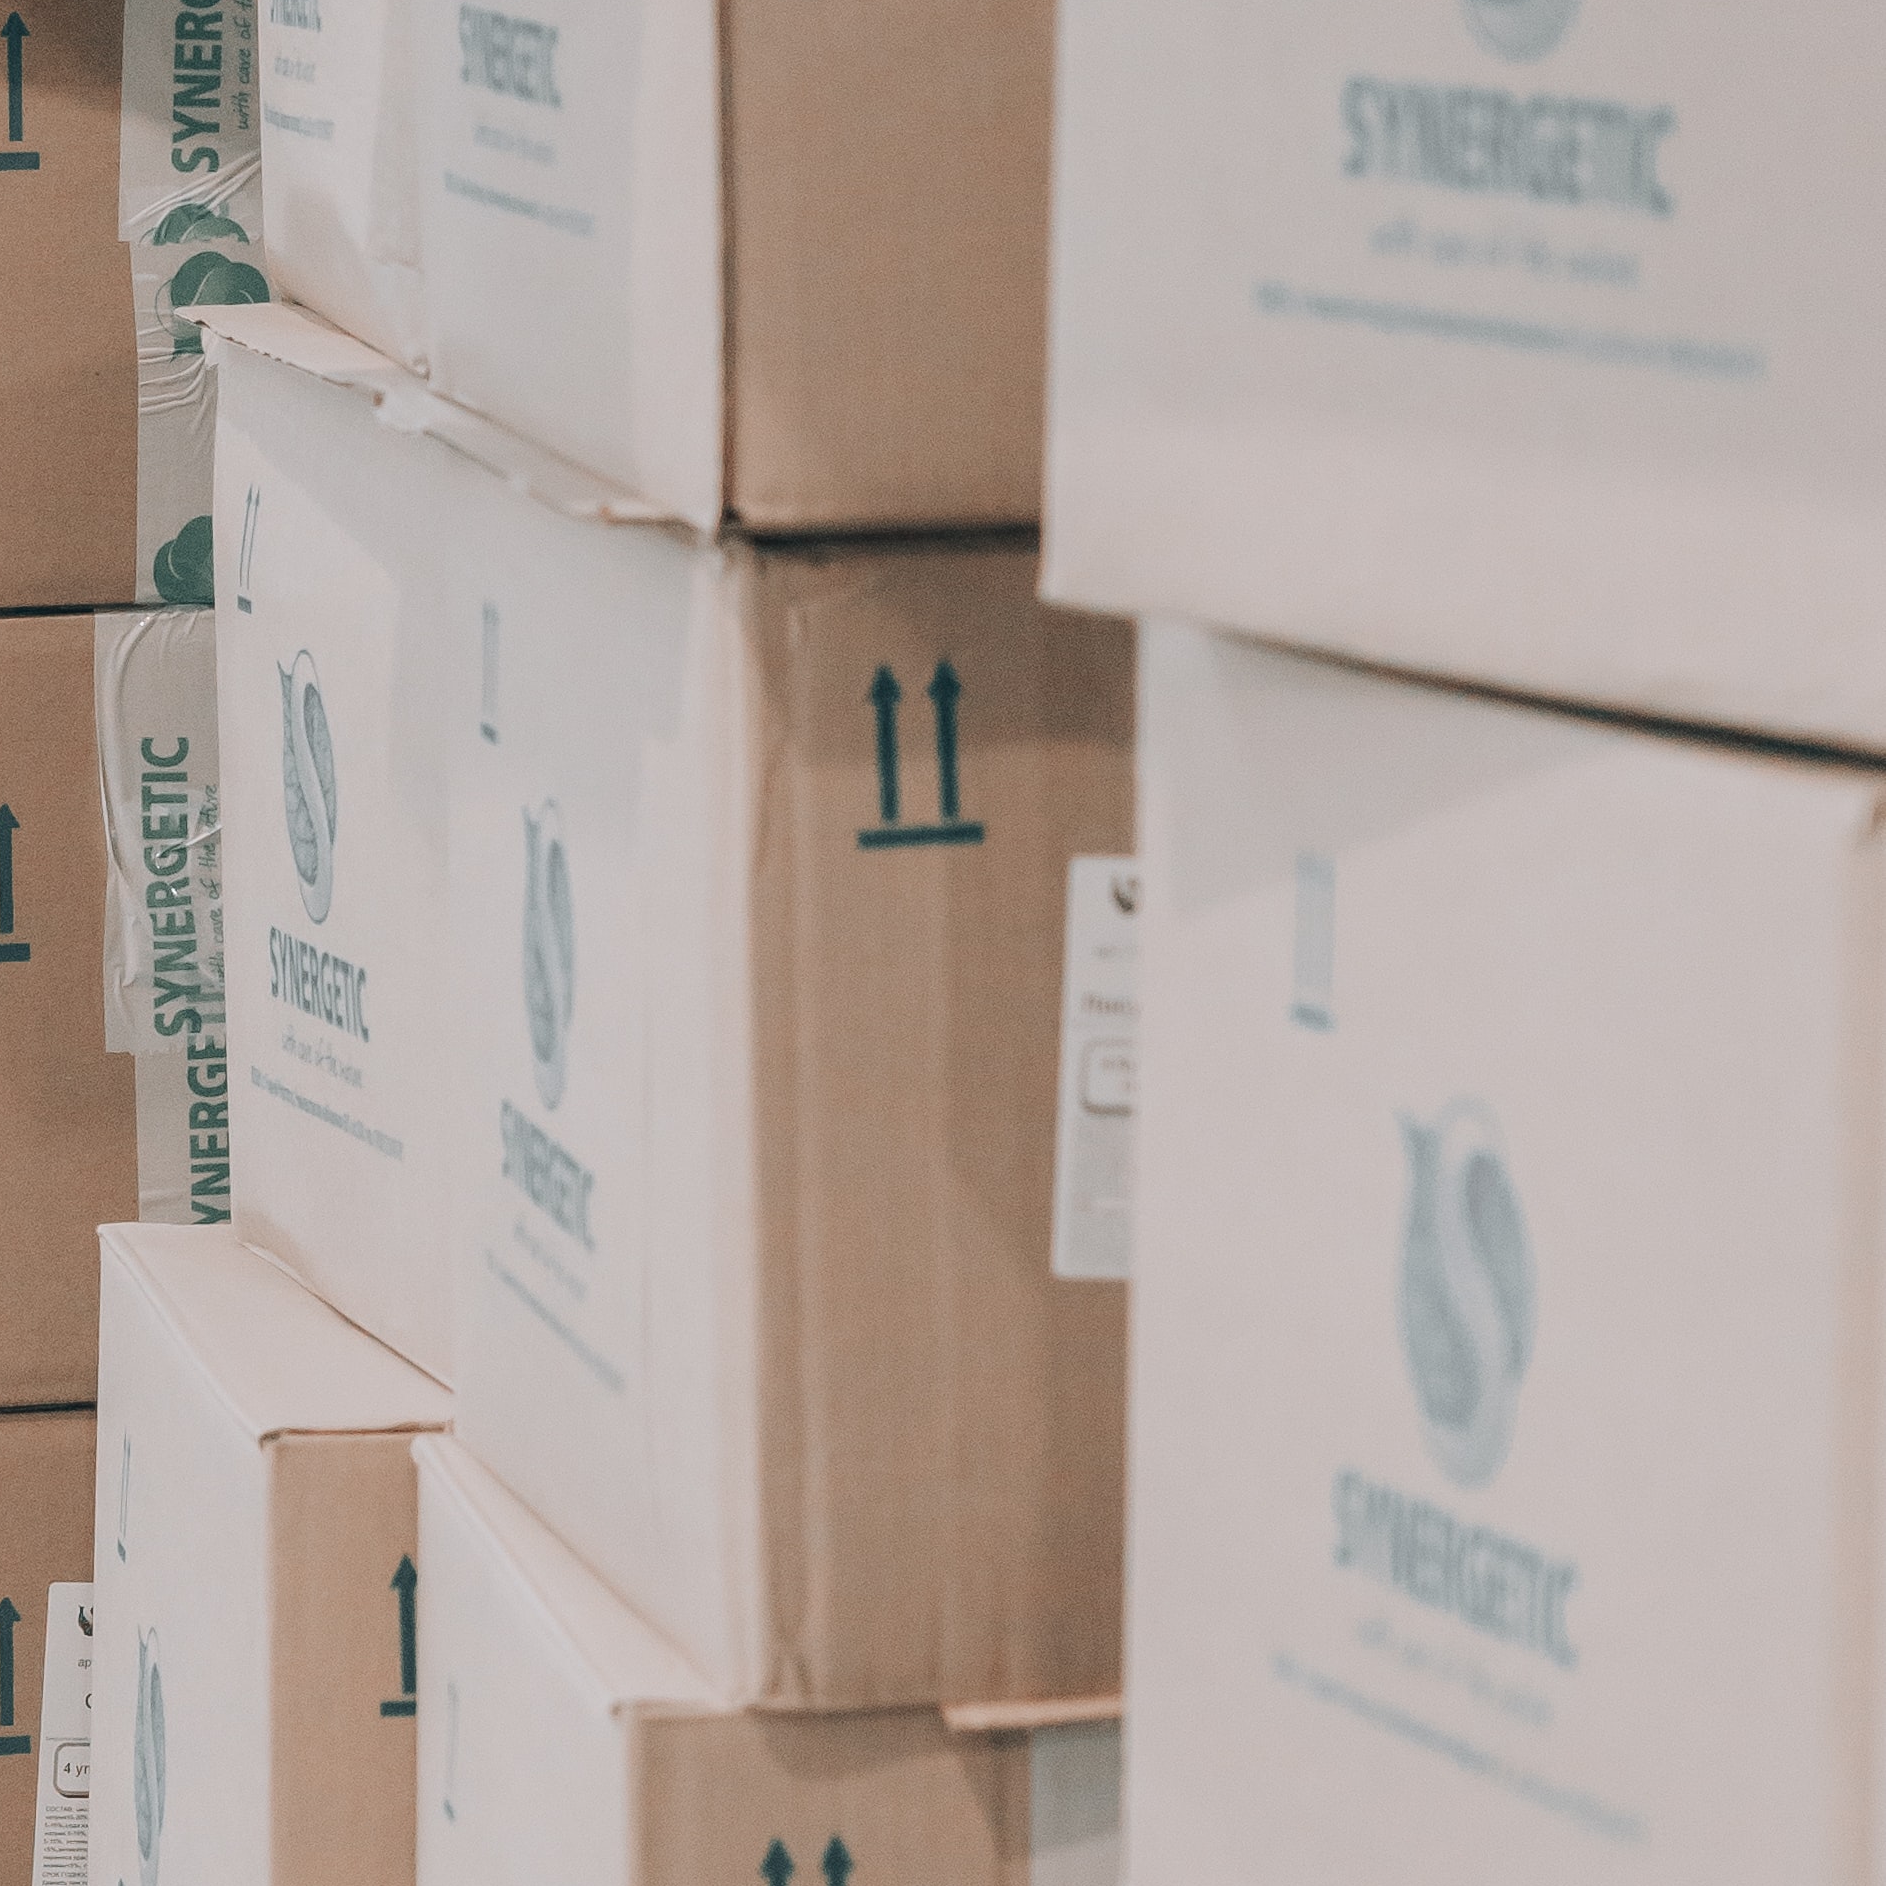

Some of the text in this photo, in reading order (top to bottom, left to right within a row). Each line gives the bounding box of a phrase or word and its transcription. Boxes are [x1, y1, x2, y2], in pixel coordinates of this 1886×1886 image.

[238, 47, 253, 85] care
[139, 736, 202, 1038] SYNERGETIC
[269, 925, 370, 1044] SYNERGETIC
[63, 1762, 72, 1776] 4
